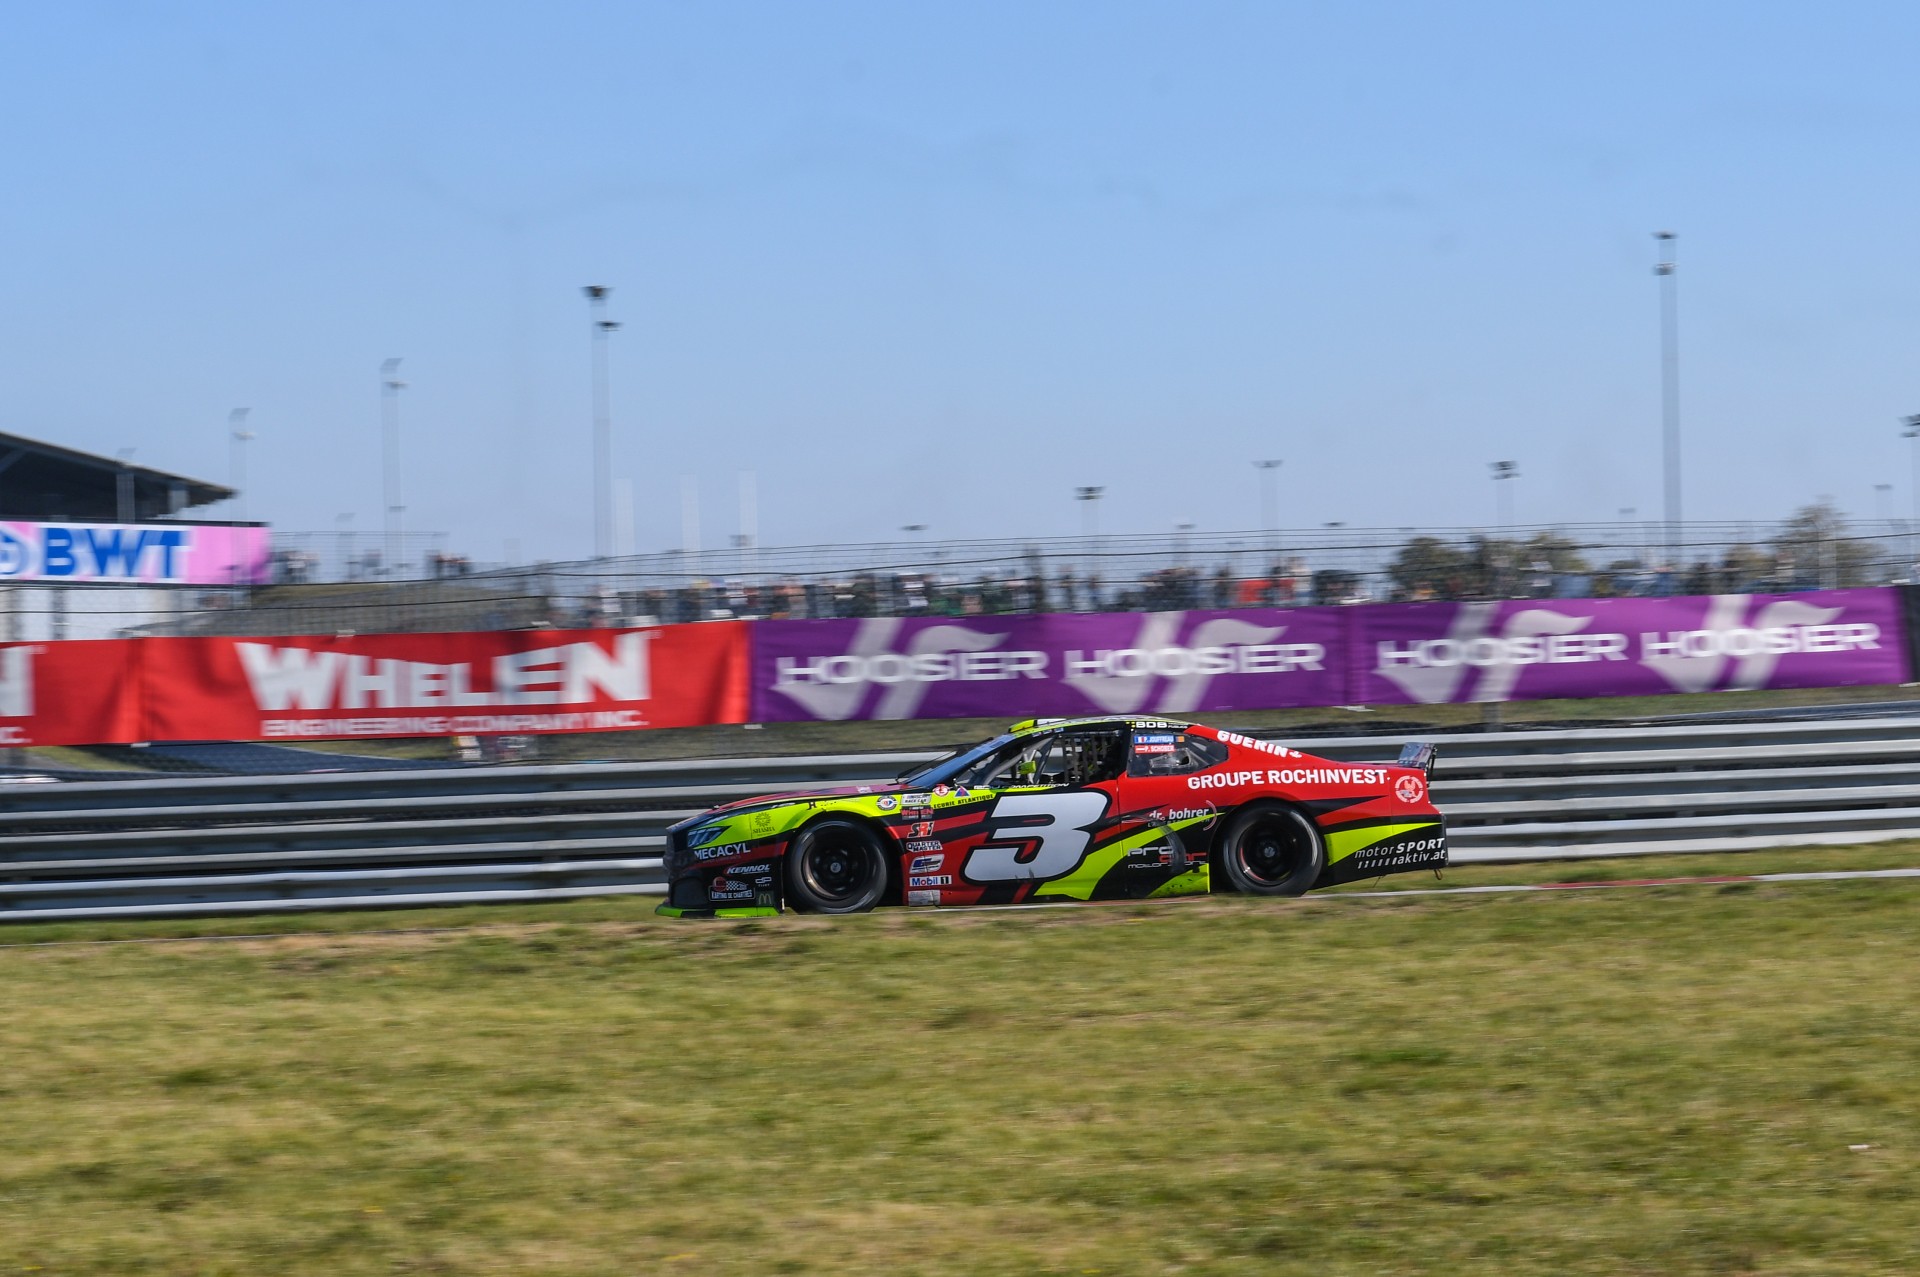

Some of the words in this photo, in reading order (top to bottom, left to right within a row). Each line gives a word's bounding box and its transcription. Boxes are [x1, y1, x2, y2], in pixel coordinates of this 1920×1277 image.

[43, 528, 187, 578] BWT
[1377, 632, 1629, 669] HOOSIER
[1640, 621, 1881, 659] HOOSIER
[234, 630, 653, 711] WHELEN
[777, 650, 1049, 685] HOOSIER
[1065, 642, 1326, 679] HOOSIER
[261, 715, 446, 738] ENGINEERING
[450, 712, 586, 736] COMPANY
[1135, 721, 1168, 729] BDB
[1217, 730, 1288, 757] GUERIN
[1187, 770, 1265, 790] GROUPE
[1268, 769, 1388, 785] ROCHINVEST
[1168, 808, 1210, 819] bohrer
[964, 791, 1108, 881] 3
[1354, 845, 1395, 860] motor
[1396, 837, 1445, 854] SPORT
[693, 843, 751, 861] MECACYL
[726, 864, 771, 874] KENNOL
[911, 876, 938, 886] Mobil
